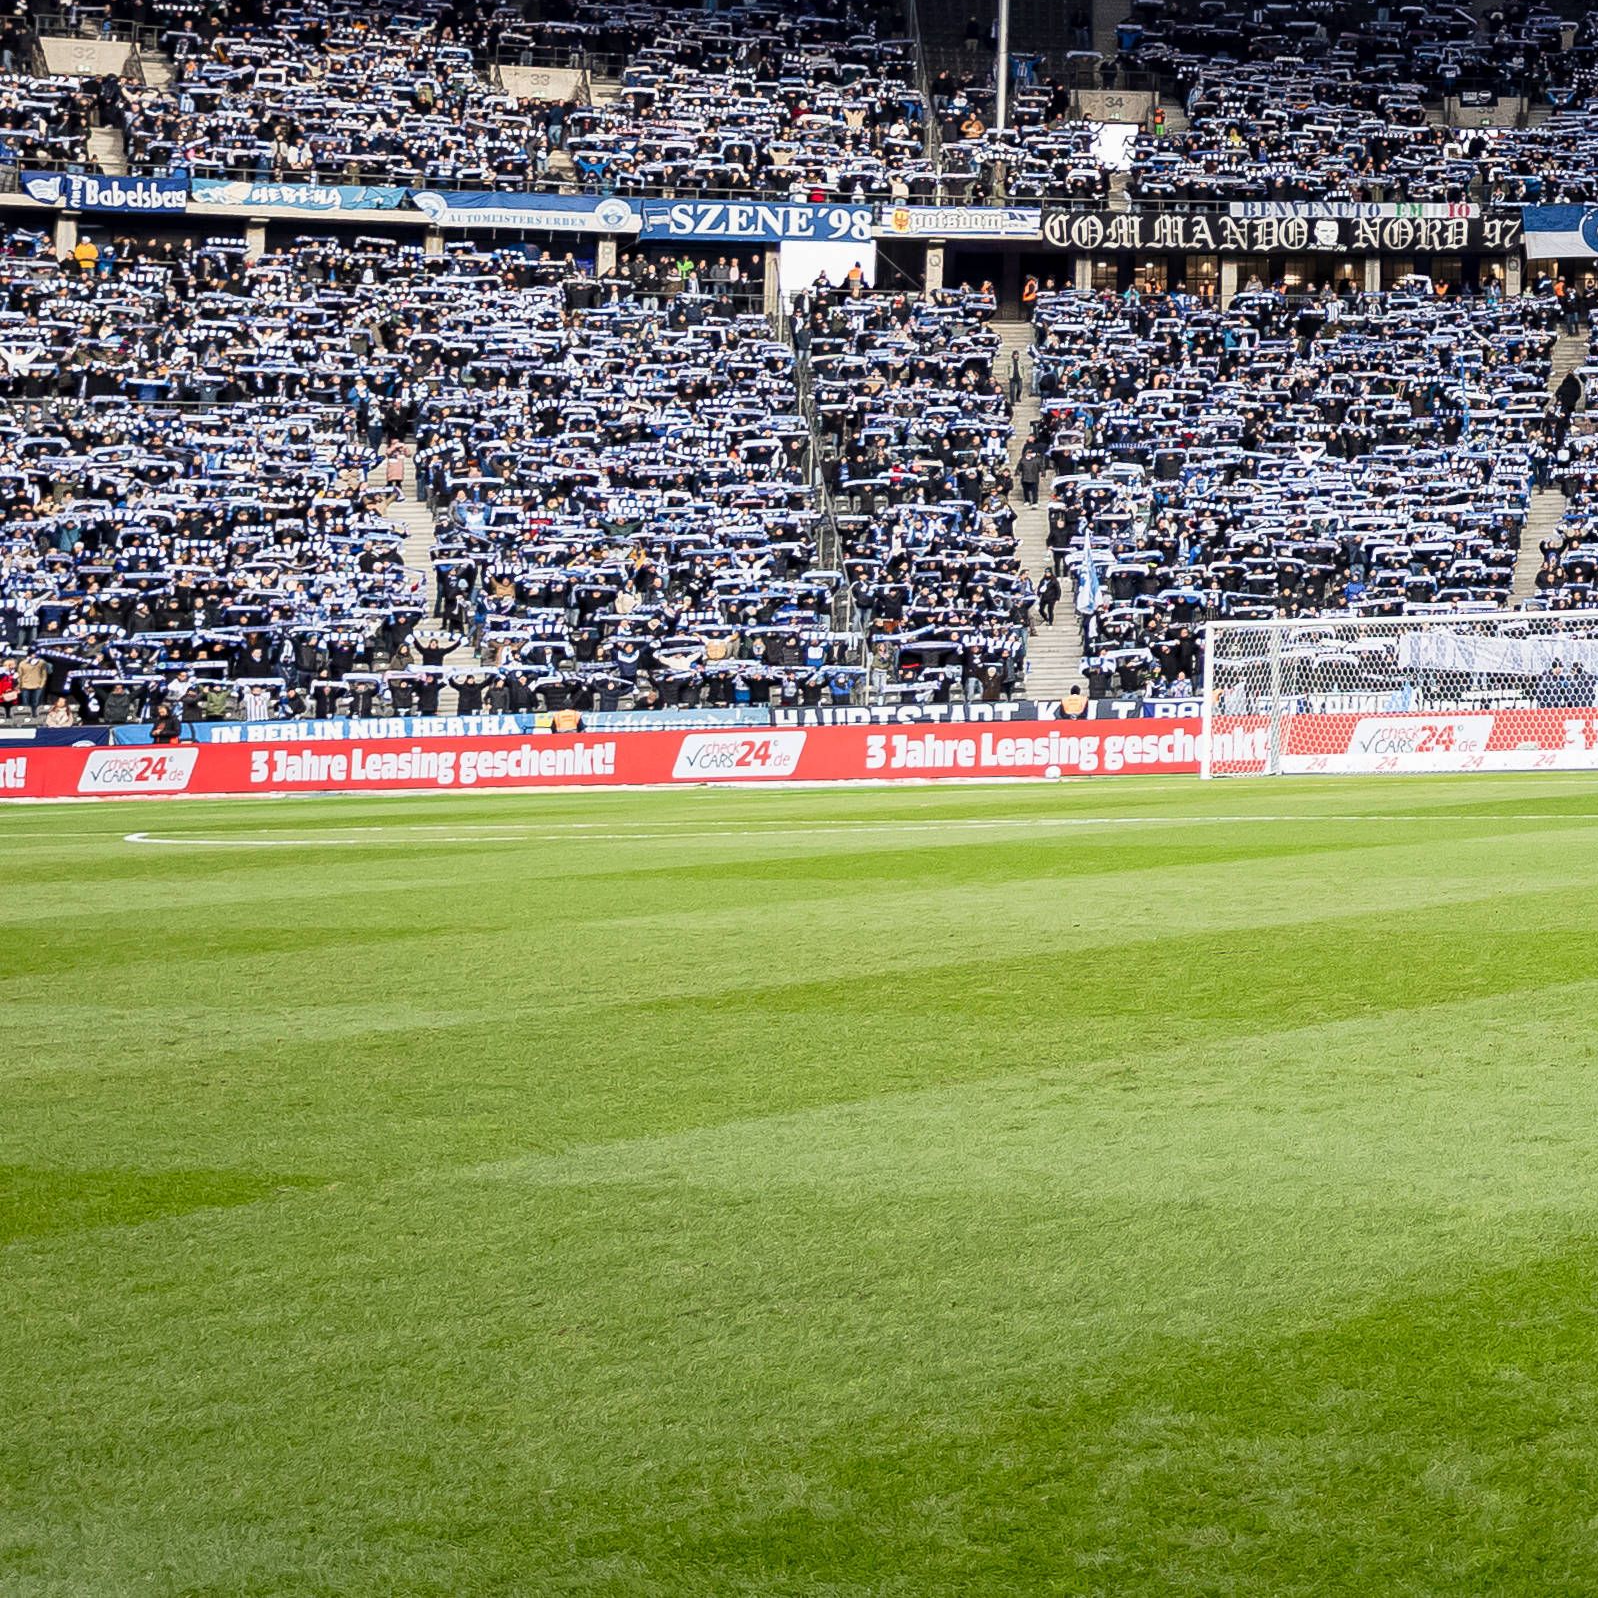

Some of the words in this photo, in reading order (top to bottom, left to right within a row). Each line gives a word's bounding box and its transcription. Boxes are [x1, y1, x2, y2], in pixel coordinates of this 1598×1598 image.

[73, 47, 96, 60] 32
[530, 74, 550, 86] 33
[1105, 96, 1125, 109] 34
[85, 179, 187, 209] Babelsberg
[909, 211, 1003, 232] potsdam
[1243, 203, 1382, 218] BENVENUTO
[1351, 216, 1469, 250] NORD
[211, 725, 242, 744] IN
[247, 720, 345, 742] BERLIN
[349, 718, 407, 740] NUR
[409, 715, 522, 739] HERTHA
[1416, 725, 1455, 752] 24
[250, 750, 268, 783] 3
[272, 749, 347, 782] Jahre
[351, 747, 455, 784] Leasing
[459, 742, 616, 784] geschenkt!
[705, 741, 740, 753] check
[735, 740, 771, 767] 24
[866, 735, 887, 769] 3
[890, 733, 976, 768] Jahre
[981, 731, 1099, 770] Leasing
[107, 757, 139, 771] check
[134, 756, 166, 782] 24
